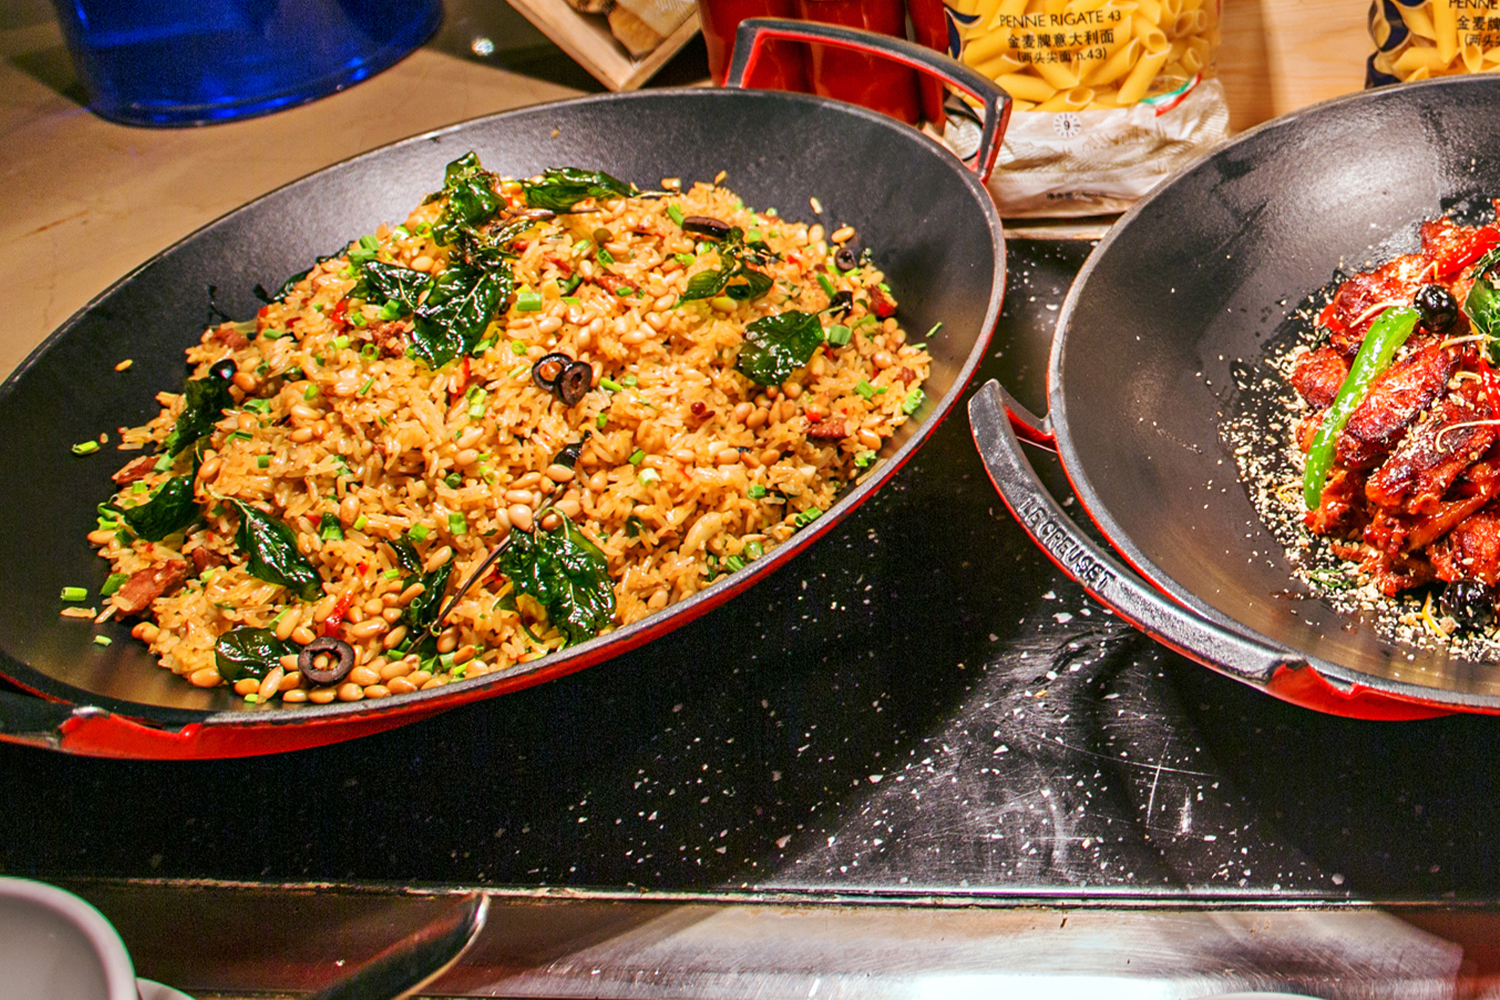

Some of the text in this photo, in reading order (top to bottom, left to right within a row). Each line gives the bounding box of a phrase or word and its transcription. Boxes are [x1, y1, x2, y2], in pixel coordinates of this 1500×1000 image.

[999, 9, 1122, 29] PENNE RIGATE 43
[1007, 28, 1115, 49] 金麦牌意大利面
[1017, 498, 1116, 593] LE CREUSET
